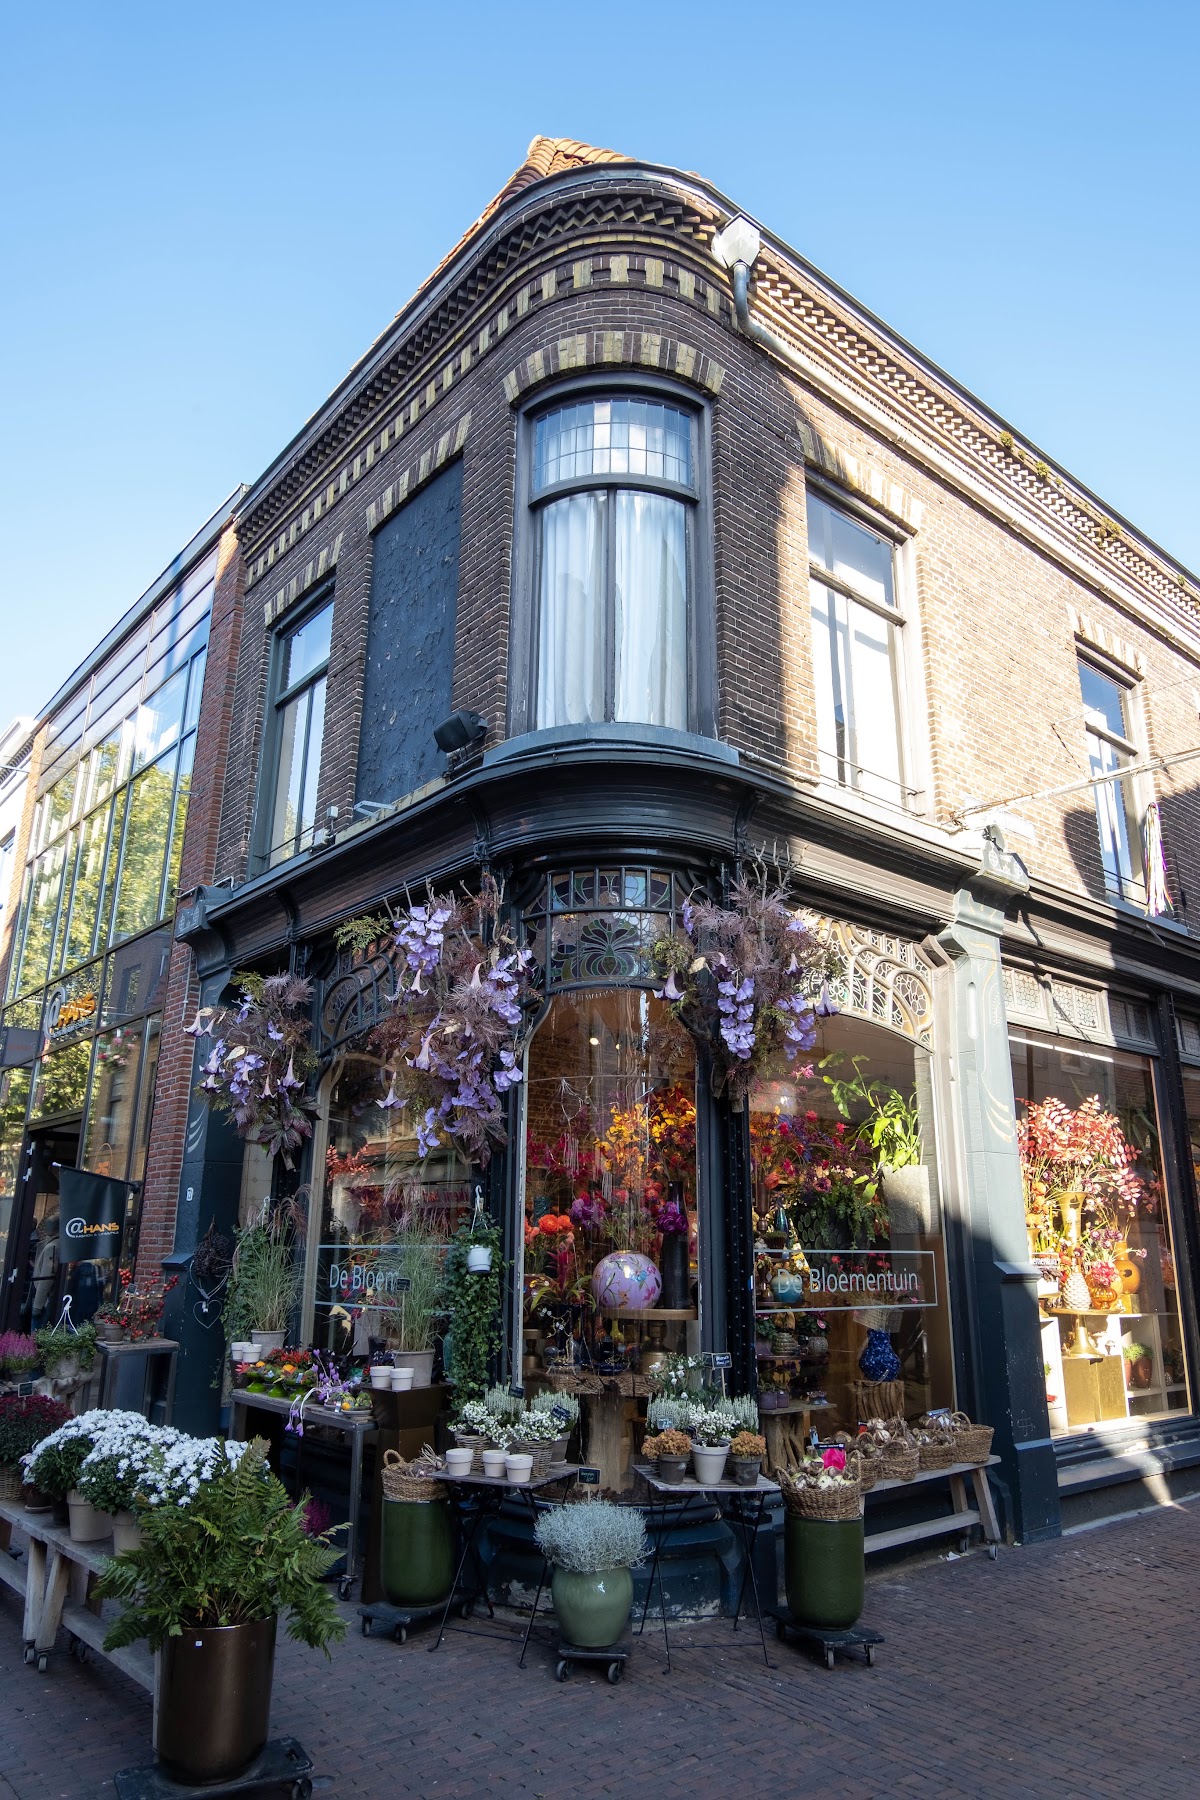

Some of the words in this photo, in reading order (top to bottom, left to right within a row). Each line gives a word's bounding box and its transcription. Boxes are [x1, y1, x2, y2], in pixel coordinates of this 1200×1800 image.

[65, 1217, 120, 1239] @HANS
[329, 1264, 348, 1289] De
[352, 1264, 399, 1292] Bloem
[776, 1268, 802, 1294] De
[809, 1266, 918, 1293] Bloementuin
